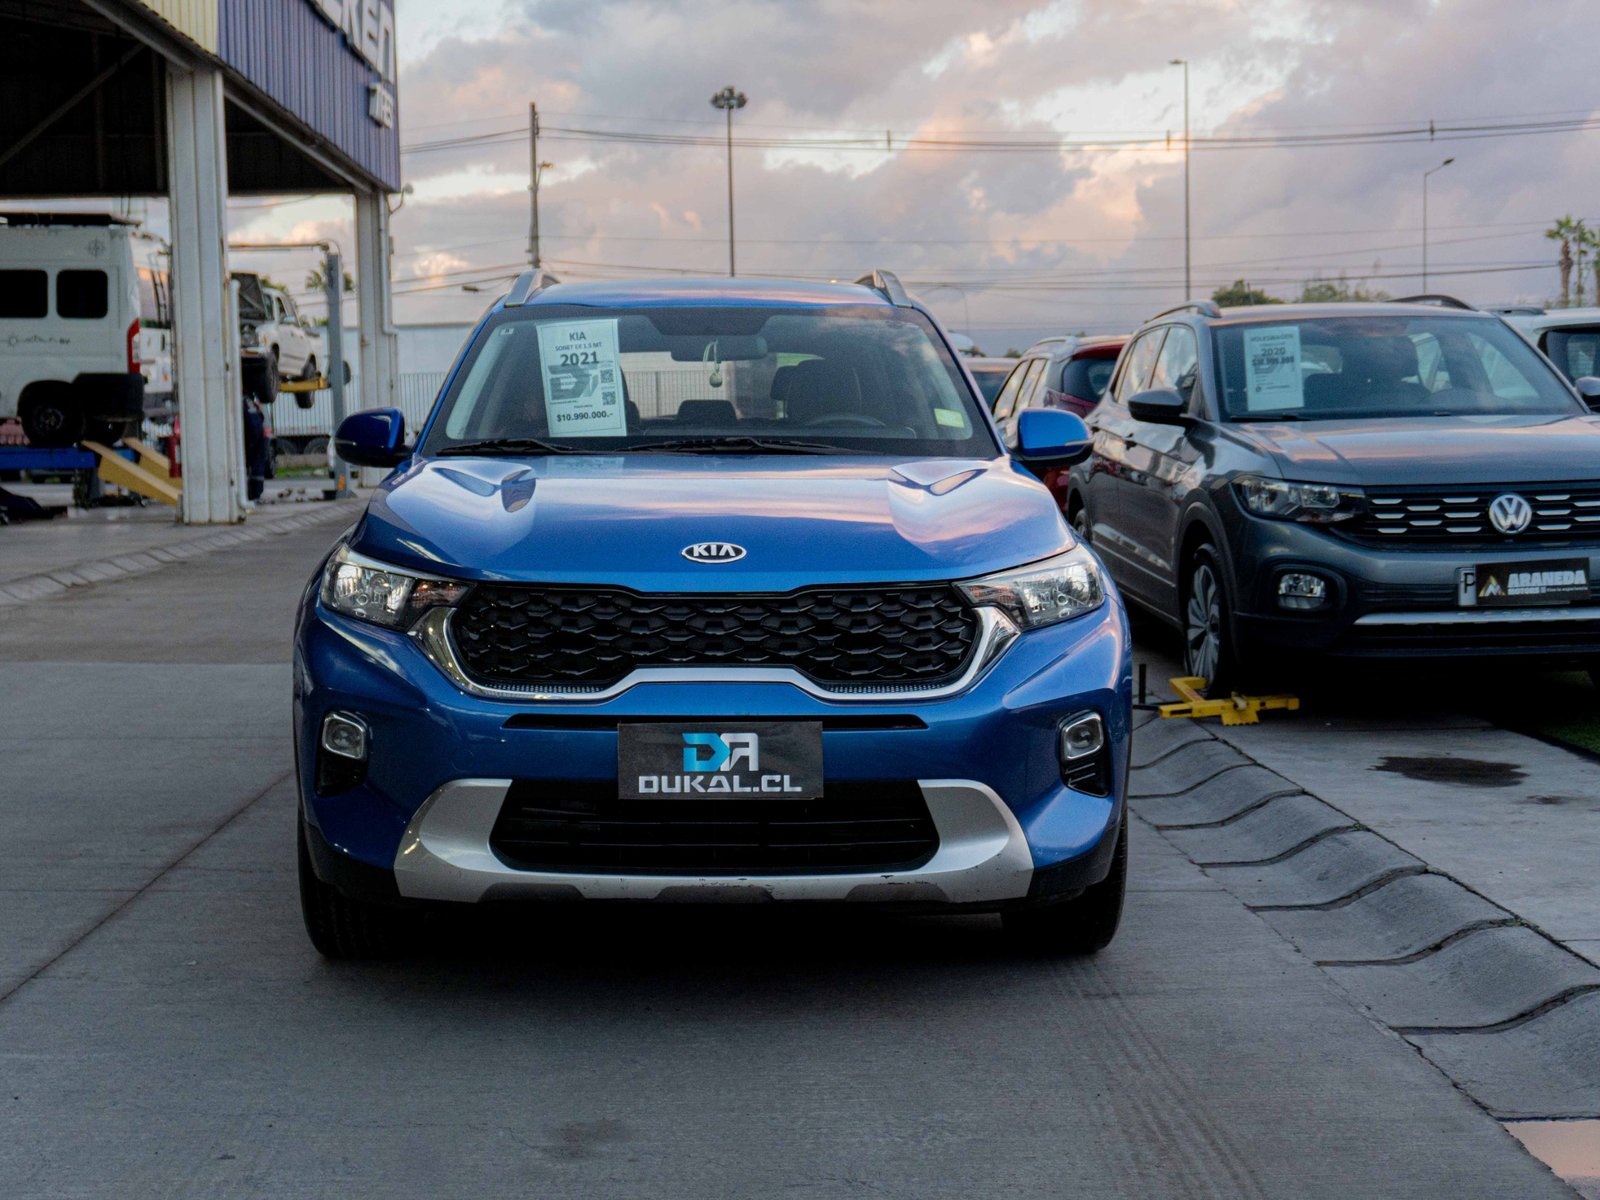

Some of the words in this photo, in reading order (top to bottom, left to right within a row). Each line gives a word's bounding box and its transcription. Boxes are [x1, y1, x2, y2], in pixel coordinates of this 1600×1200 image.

[569, 331, 587, 342] KIA
[560, 351, 600, 367] 2021
[1260, 347, 1286, 357] 2020
[693, 544, 736, 556] KIA
[1507, 570, 1587, 588] ARANEDA
[638, 774, 803, 793] DUKAL.CL
